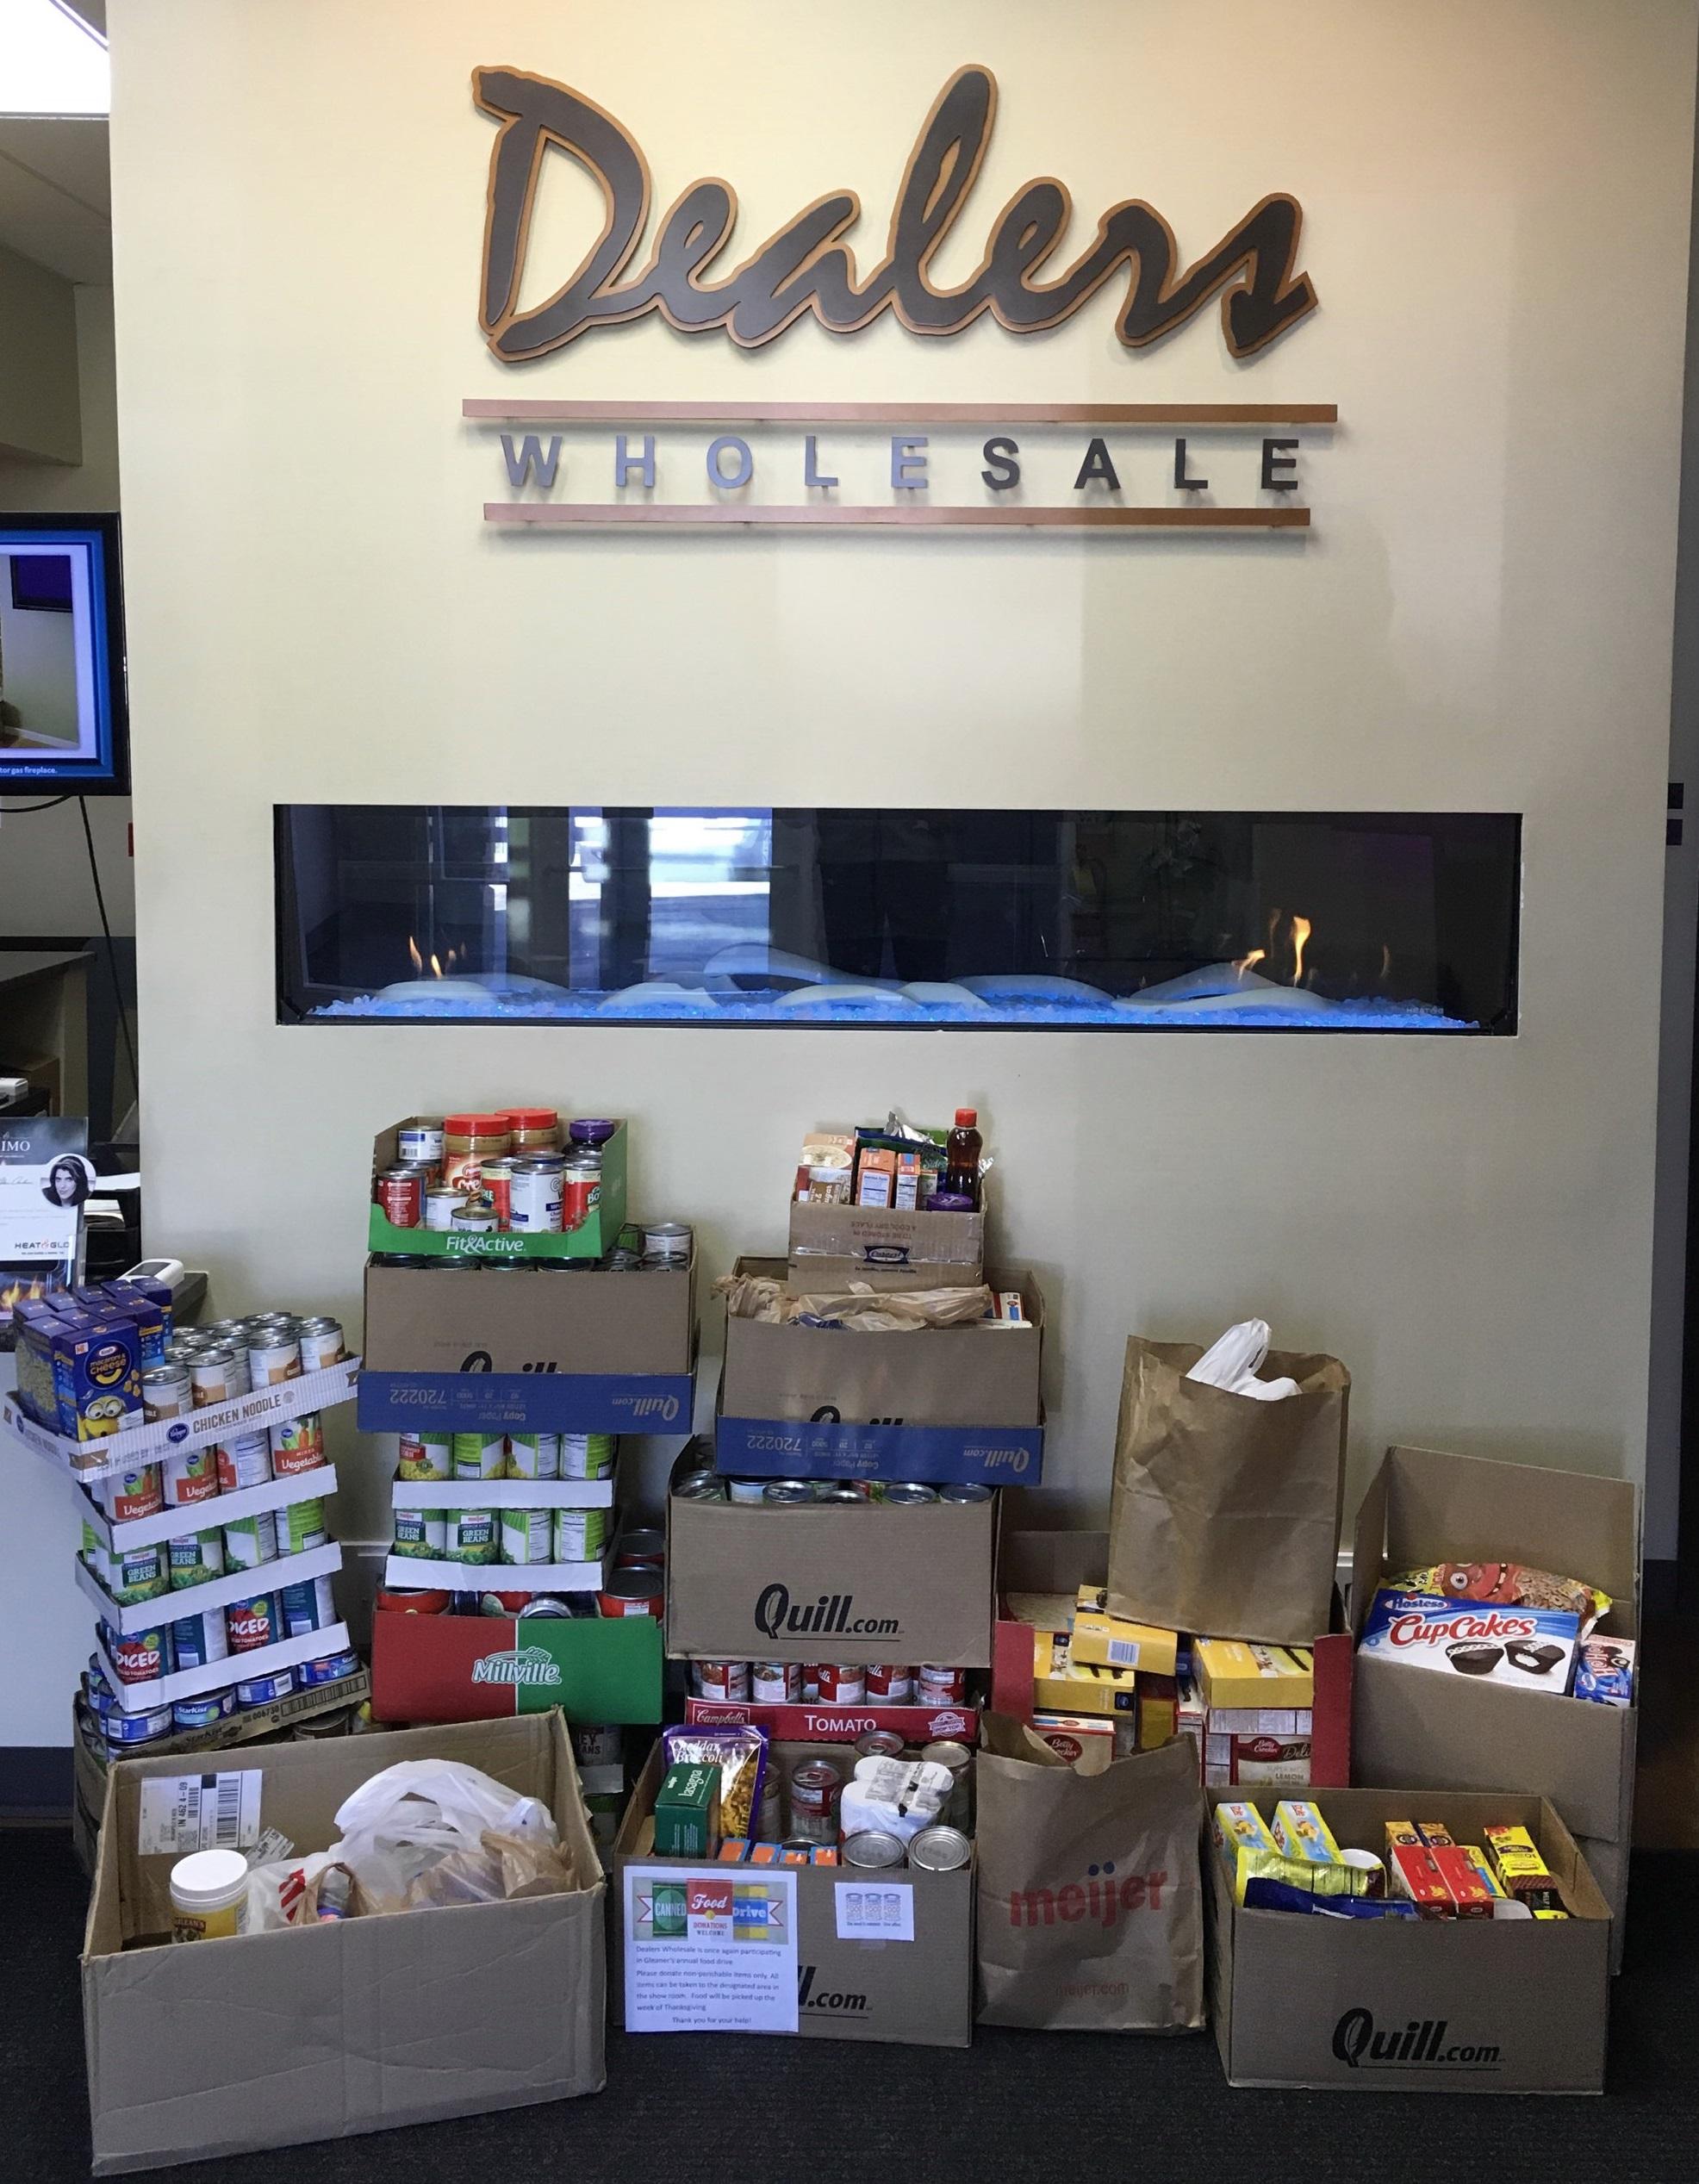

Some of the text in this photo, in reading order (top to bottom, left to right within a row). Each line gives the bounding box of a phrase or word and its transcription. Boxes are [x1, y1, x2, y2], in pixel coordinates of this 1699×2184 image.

[471, 64, 1317, 362] Dealers
[501, 434, 1298, 489] WHOLESALE
[24, 766, 58, 775] fireplace.
[445, 1235, 526, 1254] Fit&Active
[389, 1389, 446, 1404] 720222
[193, 1409, 240, 1434] CHICKEN
[242, 1394, 282, 1416] NOODLE
[612, 1395, 679, 1422] Quill.com
[747, 1434, 802, 1452] 720222
[962, 1447, 1030, 1472] Quill.com
[128, 1565, 156, 1576] GREEN
[128, 1571, 156, 1583] BEANS
[755, 1584, 899, 1640] Quill.com
[1391, 1598, 1445, 1608] Hostess
[1389, 1614, 1536, 1646] CupCakes
[473, 1658, 561, 1684] Millville
[804, 1714, 877, 1732] TOMATO
[582, 1745, 601, 1755] ANS
[1283, 1743, 1310, 1758] Deli
[678, 1769, 705, 1797] lasagna
[178, 1804, 187, 1817] 462
[178, 1819, 187, 1827] IN
[1010, 1861, 1167, 1927] meijer
[655, 1893, 767, 1919] CANNED Food Drive
[1055, 1982, 1130, 1999] meijer.com
[1332, 2007, 1500, 2068] Quill.com
